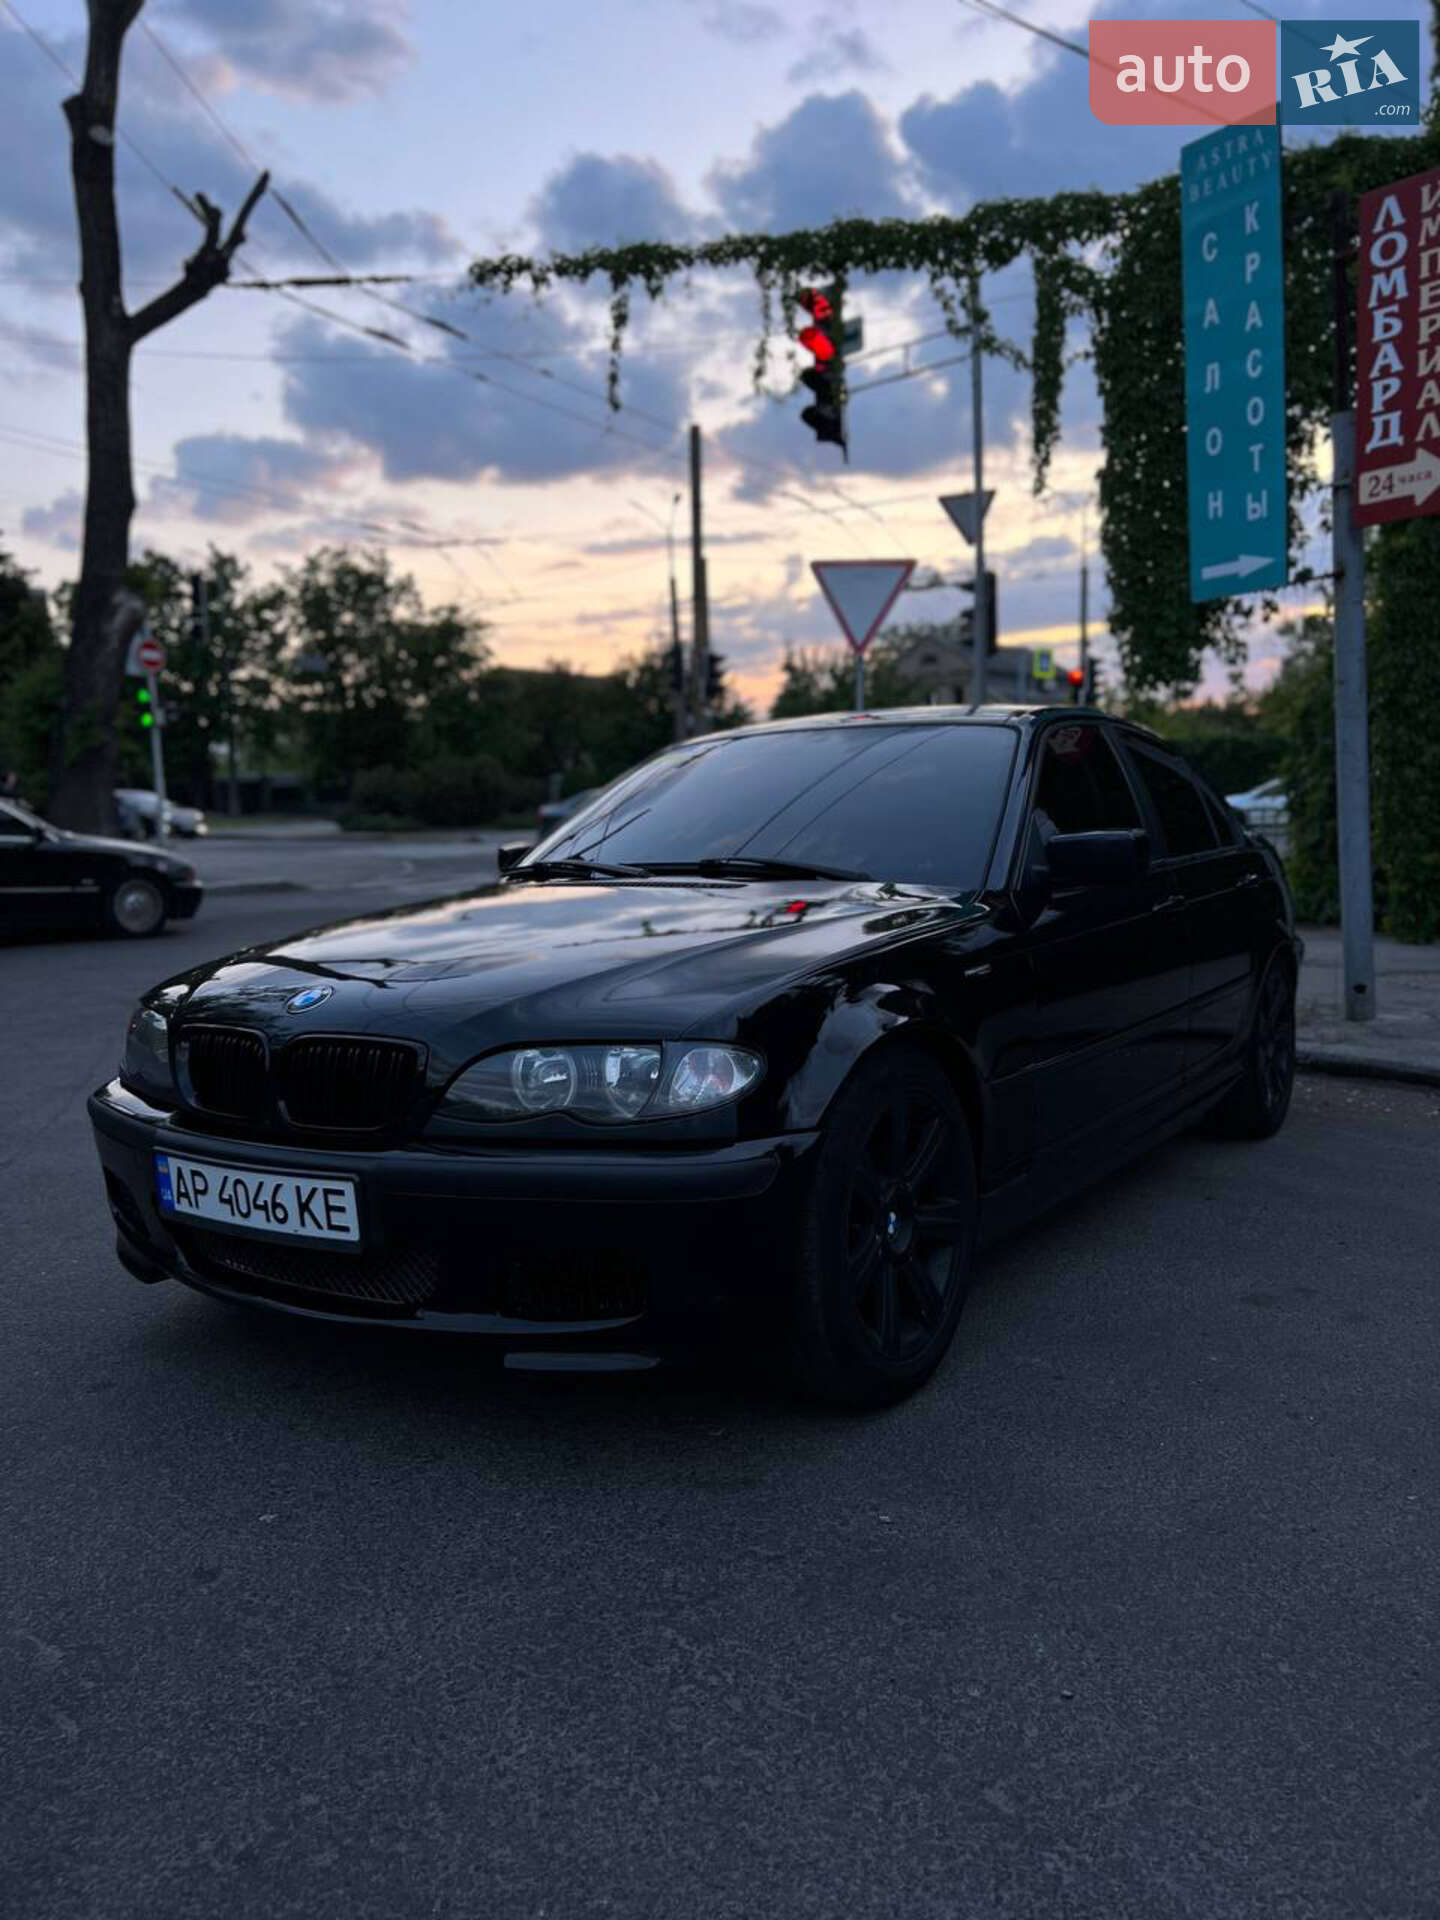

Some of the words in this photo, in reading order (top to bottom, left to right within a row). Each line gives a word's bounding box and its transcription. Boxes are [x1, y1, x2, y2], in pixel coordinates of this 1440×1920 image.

[1189, 149, 1271, 203] BEAUTY
[1198, 128, 1264, 172] ASTRA
[1365, 194, 1409, 453] ЛОМБАРД
[1202, 232, 1224, 520] САЛОН
[1244, 201, 1268, 521] КРАСОТЫ
[1367, 471, 1395, 498] 24
[175, 1165, 209, 1210] AP
[218, 1174, 289, 1225] 4046
[295, 1184, 351, 1233] KE
